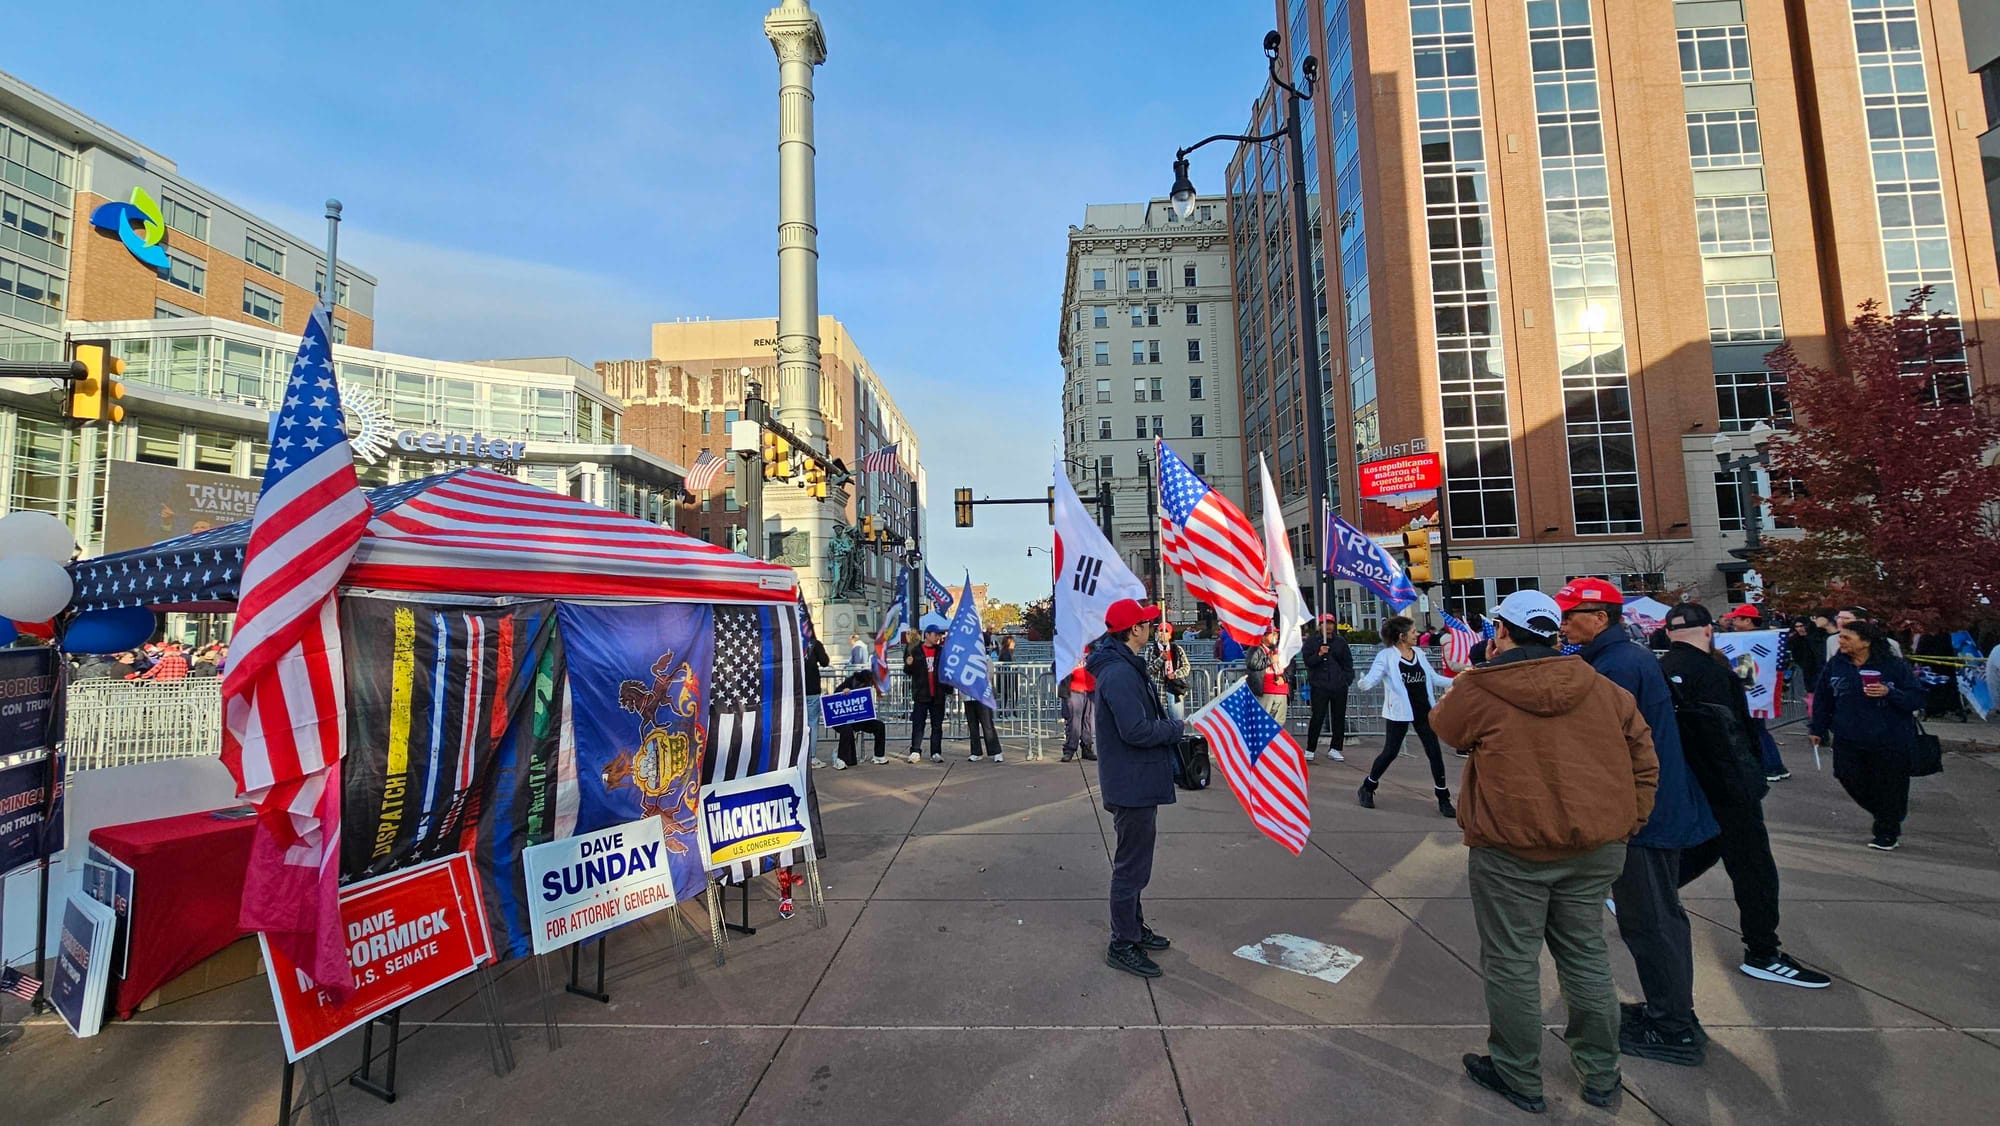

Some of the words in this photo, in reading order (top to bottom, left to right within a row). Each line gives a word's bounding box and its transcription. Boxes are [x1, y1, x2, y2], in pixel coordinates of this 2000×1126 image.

[397, 429, 526, 460] center
[1374, 468, 1410, 480] mataron
[1411, 466, 1420, 474] el
[1379, 458, 1434, 472] republicanos
[1371, 475, 1403, 487] acuerdo
[1404, 473, 1415, 482] de
[1416, 473, 1425, 481] la
[1379, 482, 1417, 493] frontera!
[195, 497, 255, 514] VANCE
[2, 702, 22, 716] CON
[827, 696, 868, 710] TRUMP
[833, 704, 865, 715] VANCE
[372, 771, 408, 859] DISPATCH
[708, 797, 796, 844] MACKENZIE
[580, 832, 624, 859] DAVE
[733, 847, 746, 855] U.S.
[746, 836, 781, 852] CONGRESS
[542, 840, 660, 902] SUNDAY
[546, 916, 568, 941] FOR
[570, 897, 620, 933] ATTORNEY
[624, 883, 670, 912] GENERAL
[347, 908, 397, 942] DAVE
[385, 940, 439, 976] SENATE
